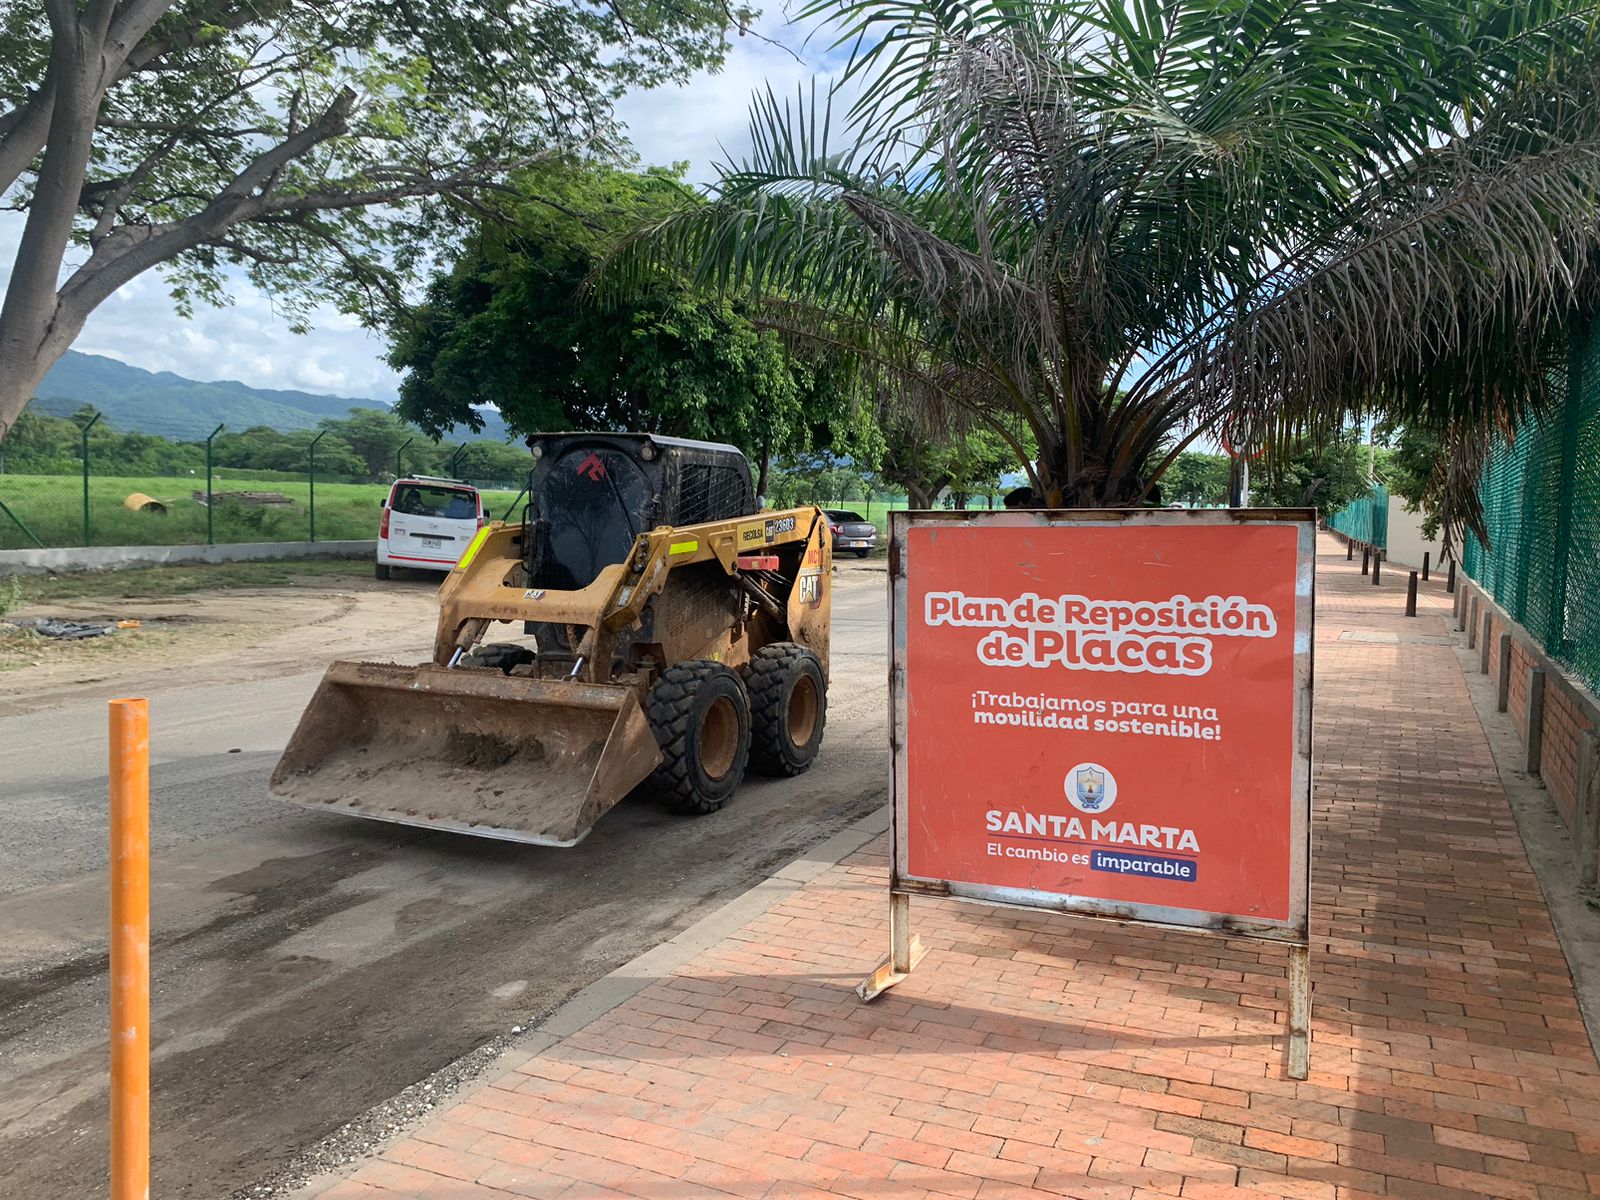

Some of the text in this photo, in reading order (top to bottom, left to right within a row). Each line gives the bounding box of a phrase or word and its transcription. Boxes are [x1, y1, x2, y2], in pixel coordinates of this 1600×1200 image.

[799, 575, 819, 605] CAT
[930, 596, 1270, 632] Plan de Reposición
[982, 630, 1207, 670] de Placas
[971, 690, 1219, 721] ¡Trabajamos para una
[973, 711, 1222, 741] movilidad sostenible!
[985, 810, 1201, 853] SANTA MARTA
[986, 842, 1192, 879] El cambio es imparable
